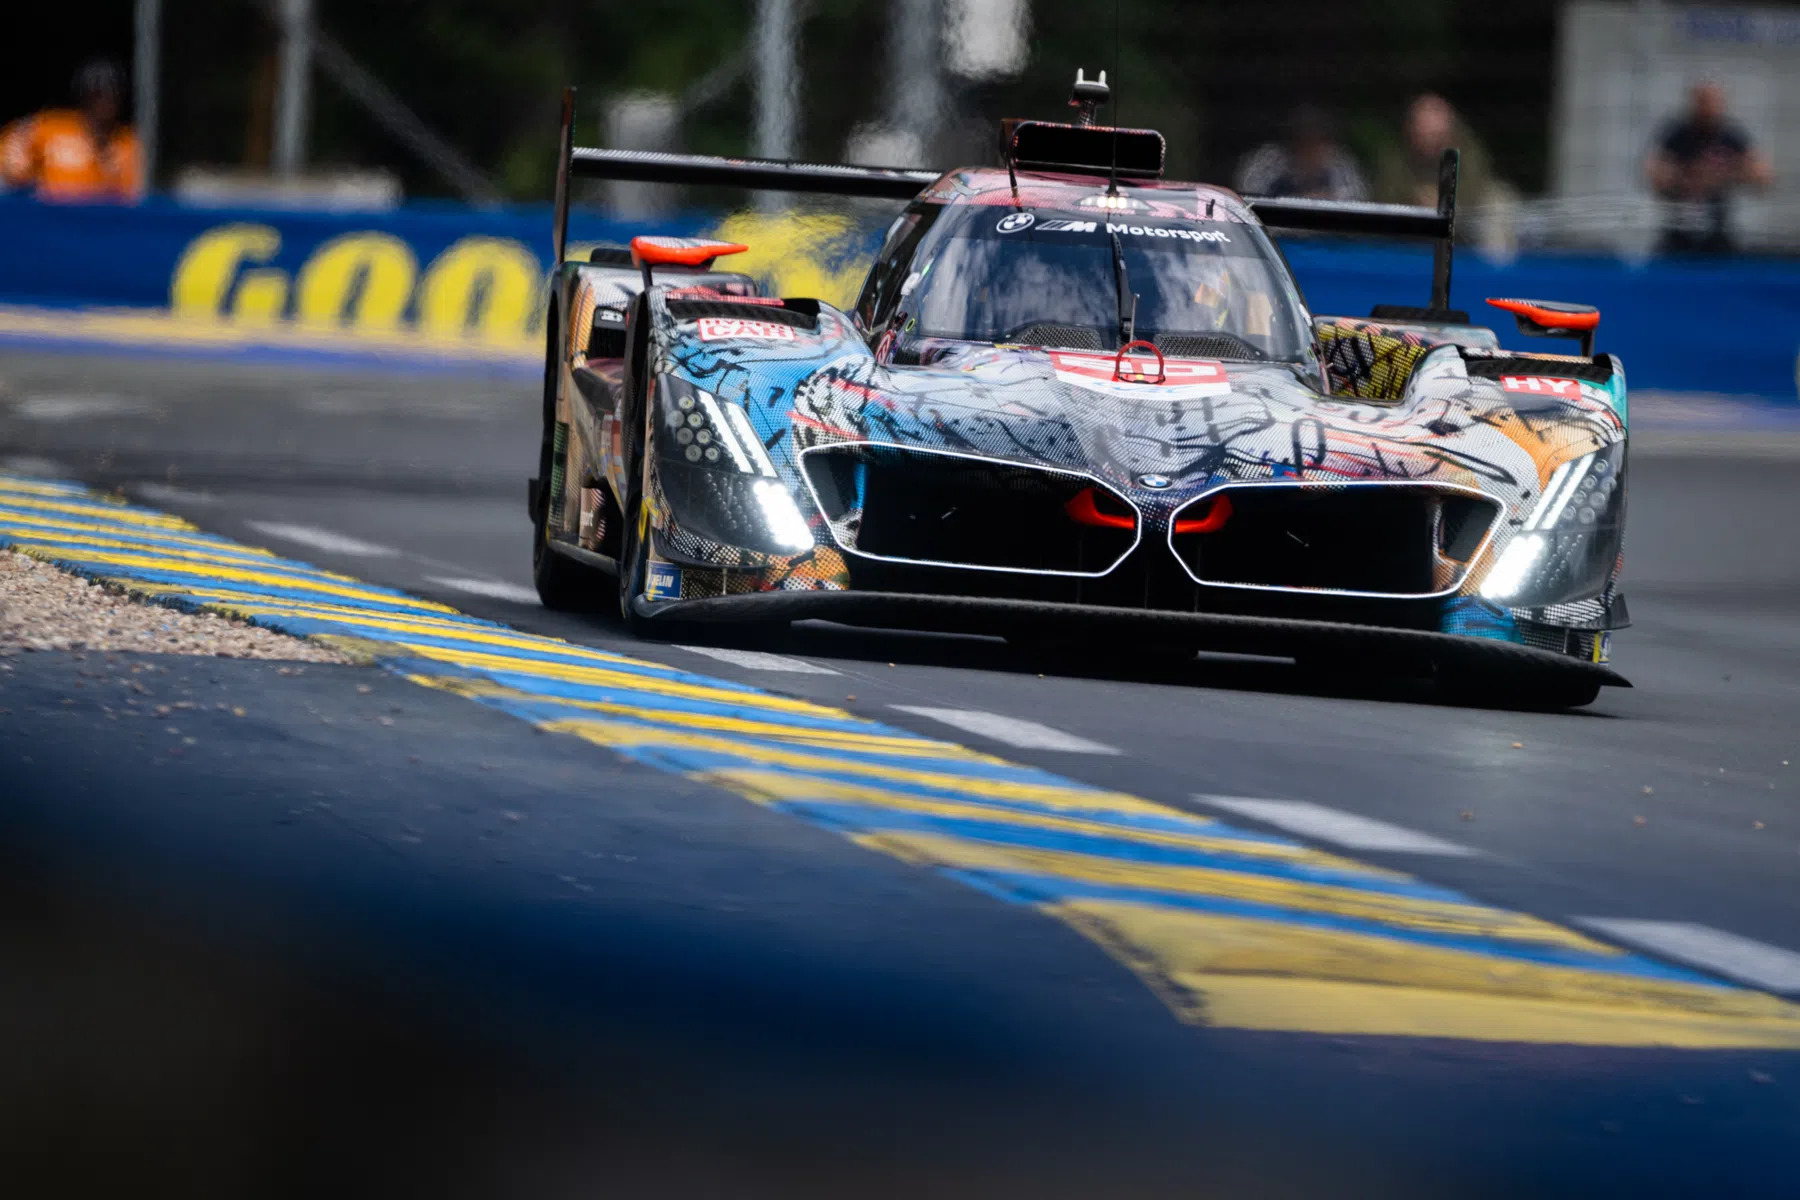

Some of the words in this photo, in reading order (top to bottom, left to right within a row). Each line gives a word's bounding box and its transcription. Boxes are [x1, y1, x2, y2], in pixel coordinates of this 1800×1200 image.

[1106, 222, 1231, 243] Motorsport
[170, 222, 548, 340] GOO
[1504, 377, 1574, 394] HY
